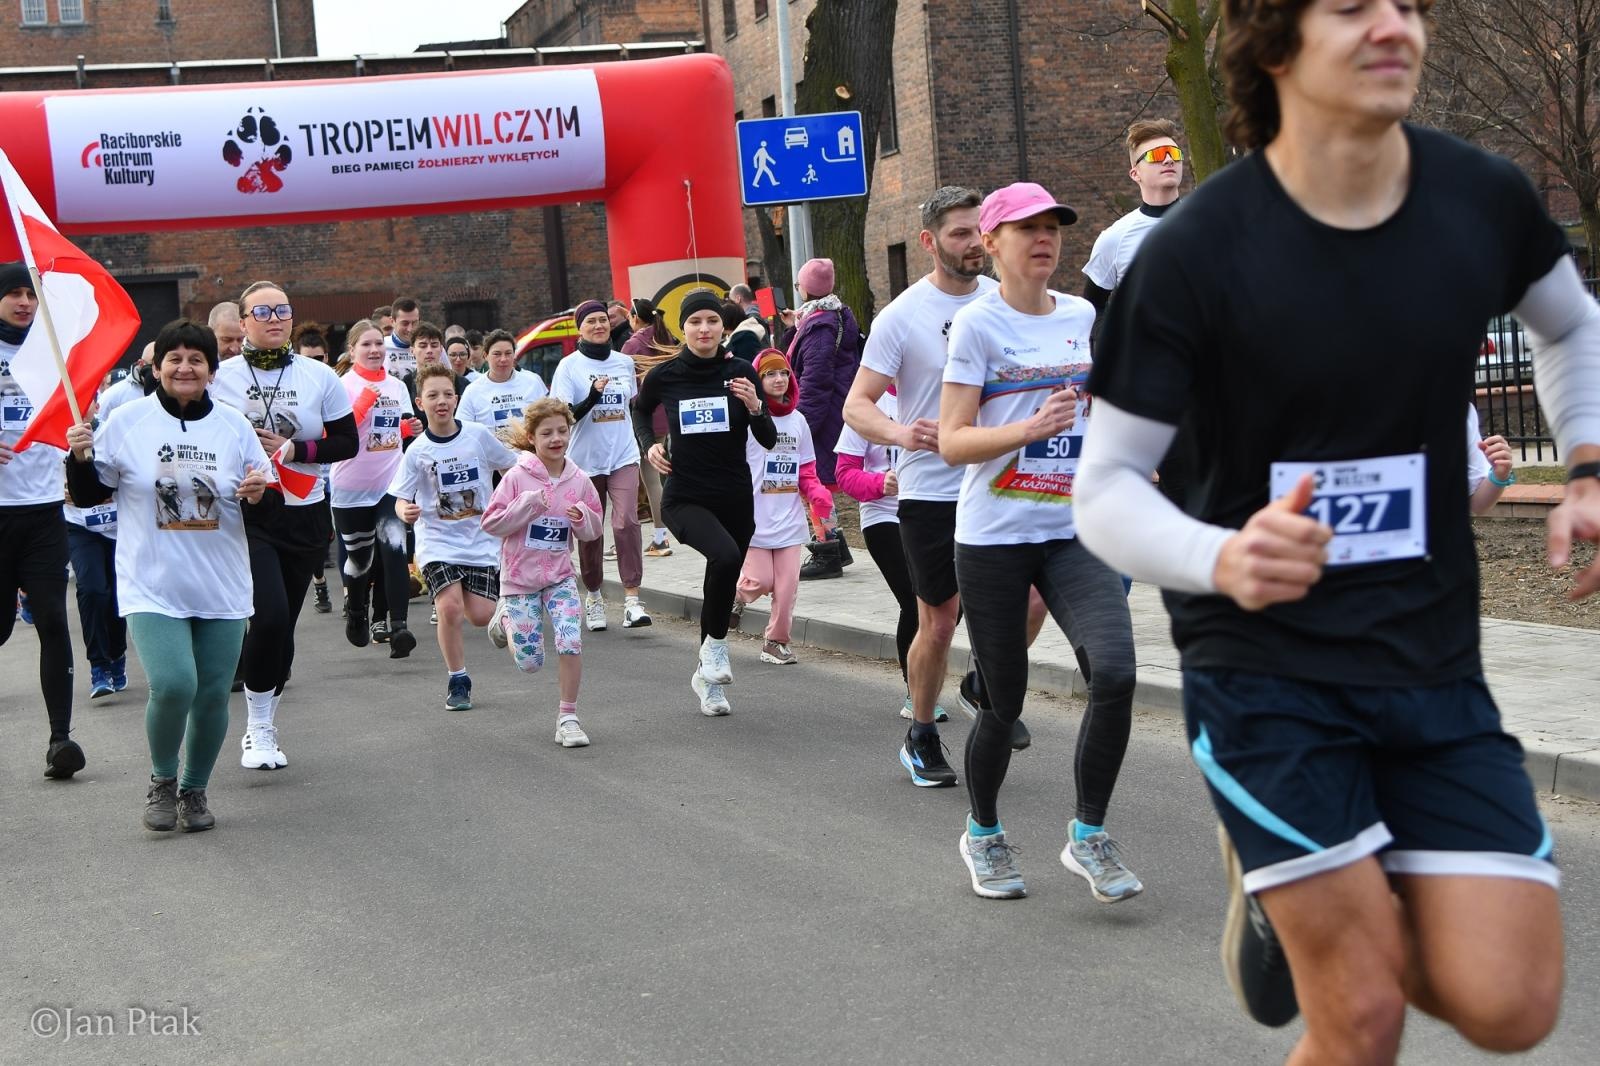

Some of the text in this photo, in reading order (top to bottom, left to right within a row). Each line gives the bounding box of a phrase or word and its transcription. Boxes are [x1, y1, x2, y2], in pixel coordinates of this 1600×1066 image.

[100, 131, 182, 149] Raciborskie
[332, 149, 559, 174] BIEG PAMIĘCI ŻOŁNIERZY WYKLĘTYCH
[104, 168, 154, 186] Kultury
[601, 394, 618, 404] 106
[383, 417, 395, 427] 37
[695, 410, 714, 423] 58
[1046, 437, 1070, 457] 50
[177, 450, 217, 461] WILCZYM
[775, 462, 793, 473] 107
[453, 470, 470, 484] 23
[97, 512, 112, 524] 12
[1309, 493, 1390, 533] 127
[543, 528, 561, 541] 22
